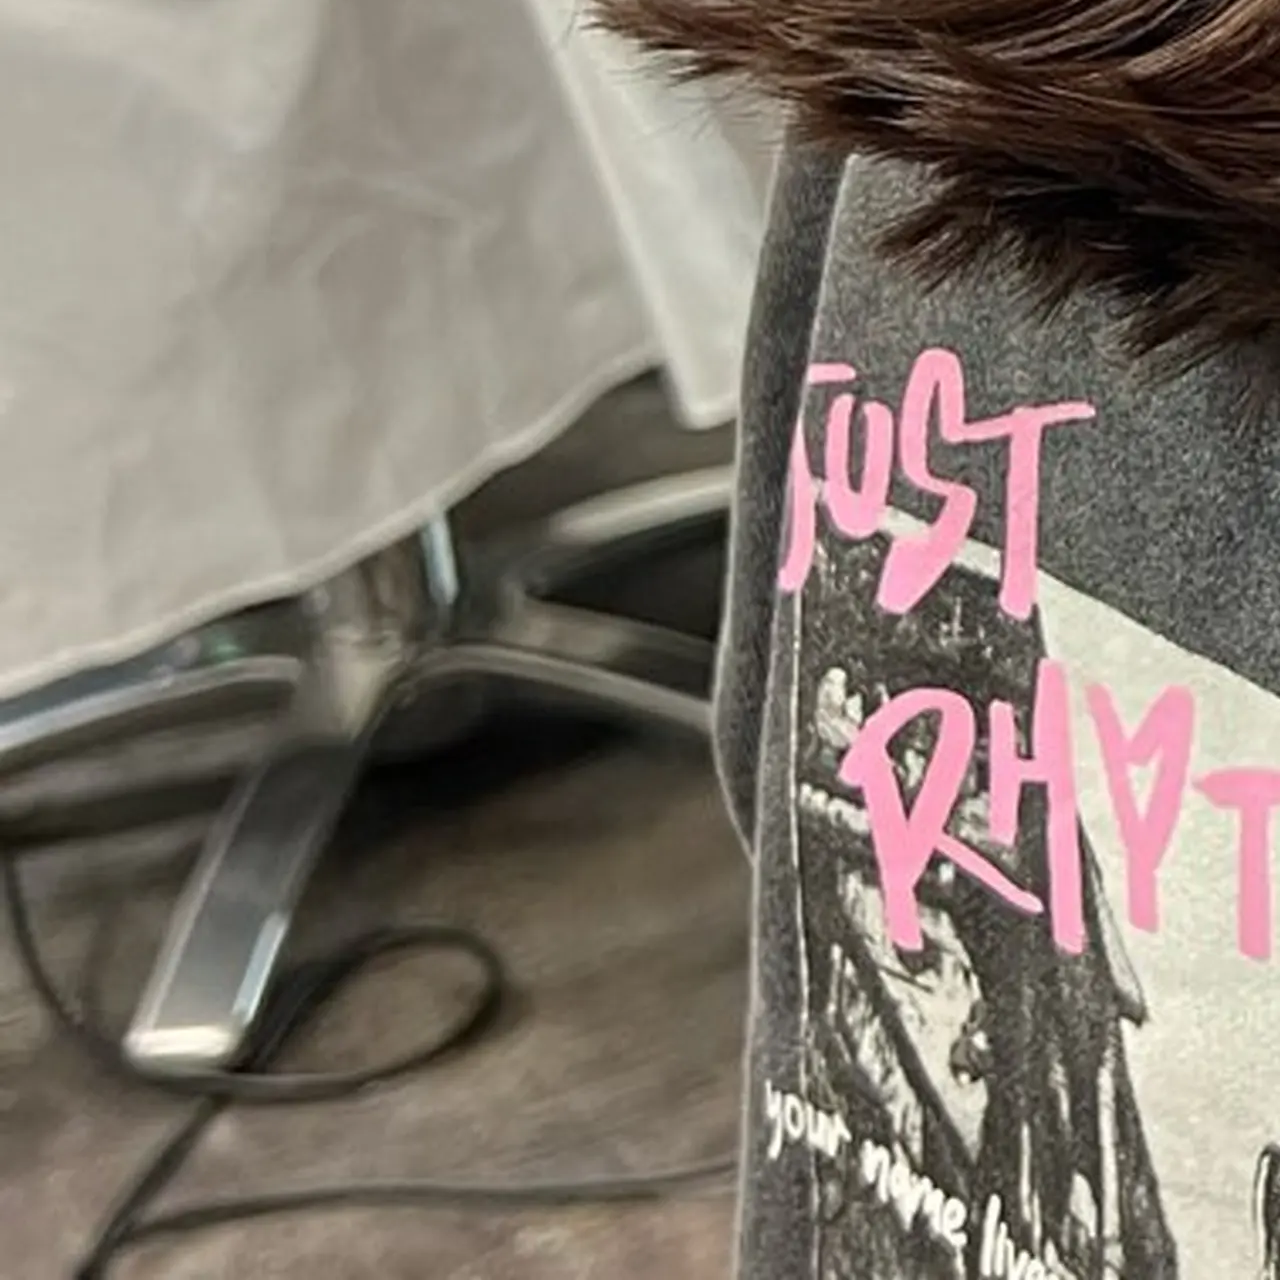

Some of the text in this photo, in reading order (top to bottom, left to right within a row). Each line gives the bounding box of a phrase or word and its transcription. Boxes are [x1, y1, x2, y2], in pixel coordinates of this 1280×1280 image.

[779, 348, 1095, 620] JUST
[766, 1078, 851, 1161] your
[860, 1138, 967, 1248] name
